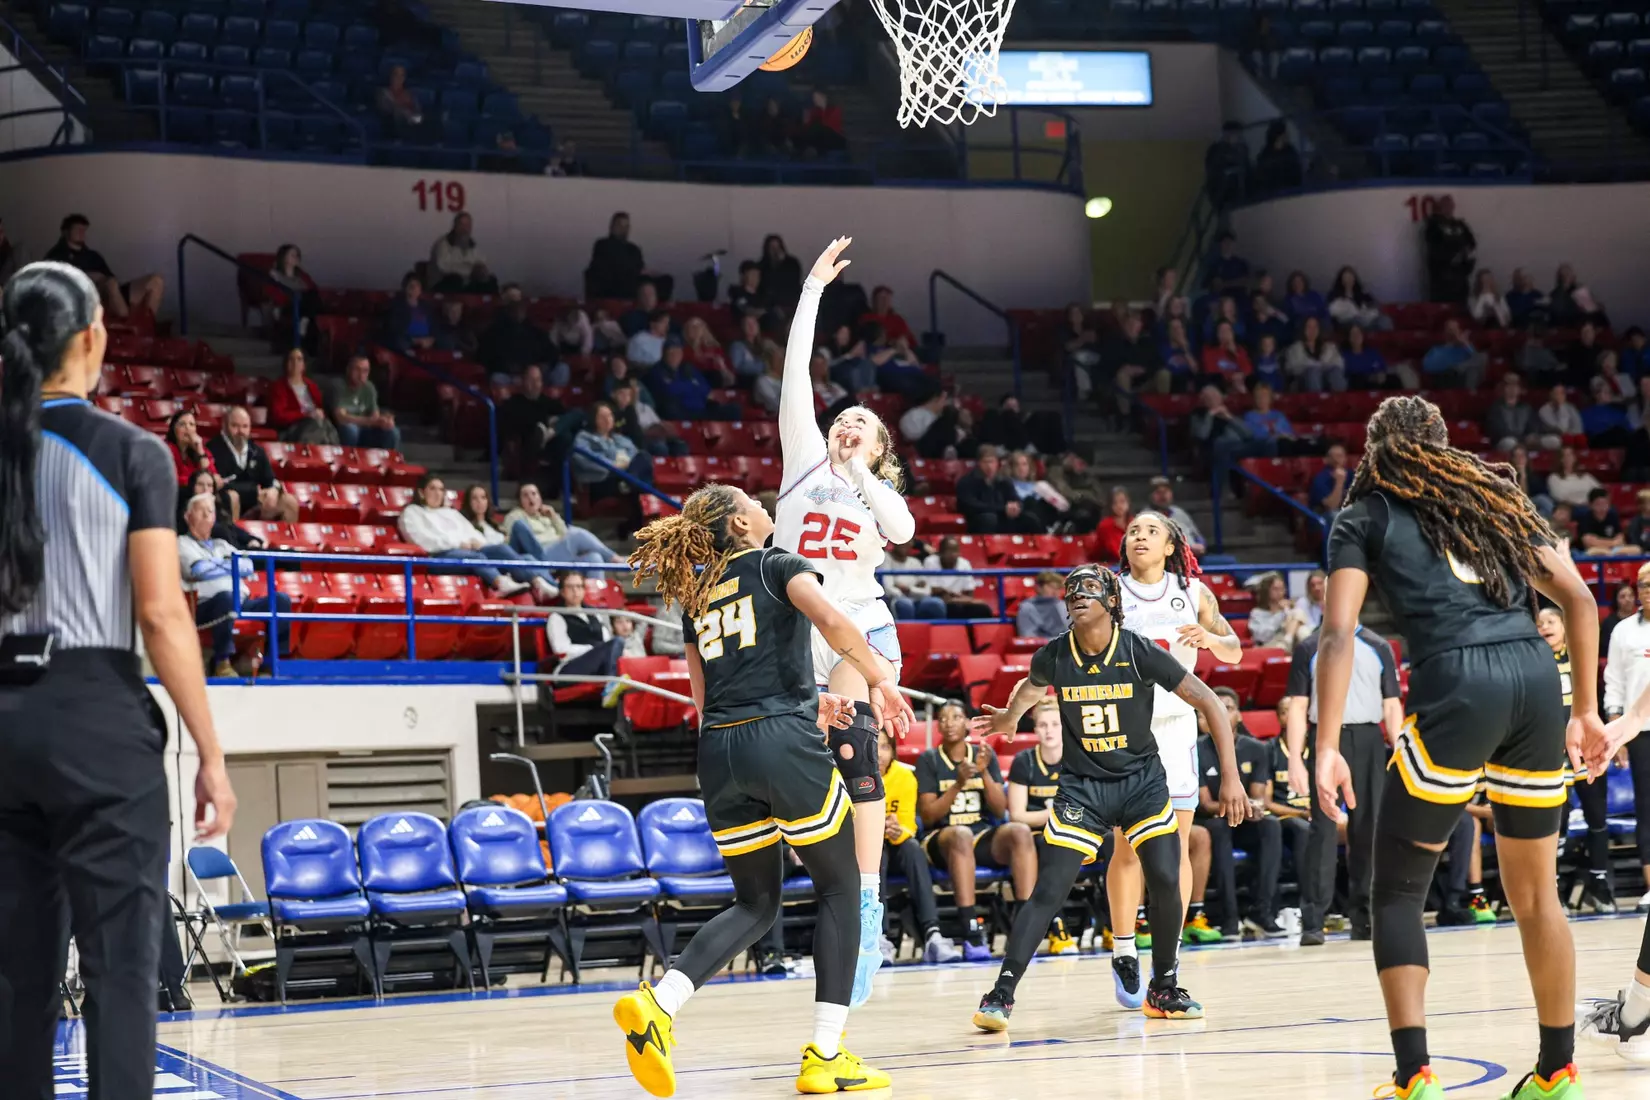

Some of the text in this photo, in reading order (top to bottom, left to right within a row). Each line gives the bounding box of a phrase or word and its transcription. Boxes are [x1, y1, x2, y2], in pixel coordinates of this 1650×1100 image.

[412, 179, 465, 212] 119
[1403, 195, 1439, 222] 10
[797, 511, 861, 560] 25
[692, 594, 757, 663] 24
[1061, 683, 1133, 702] KENNESAW
[1081, 703, 1120, 734] 21
[1081, 734, 1128, 753] STATE
